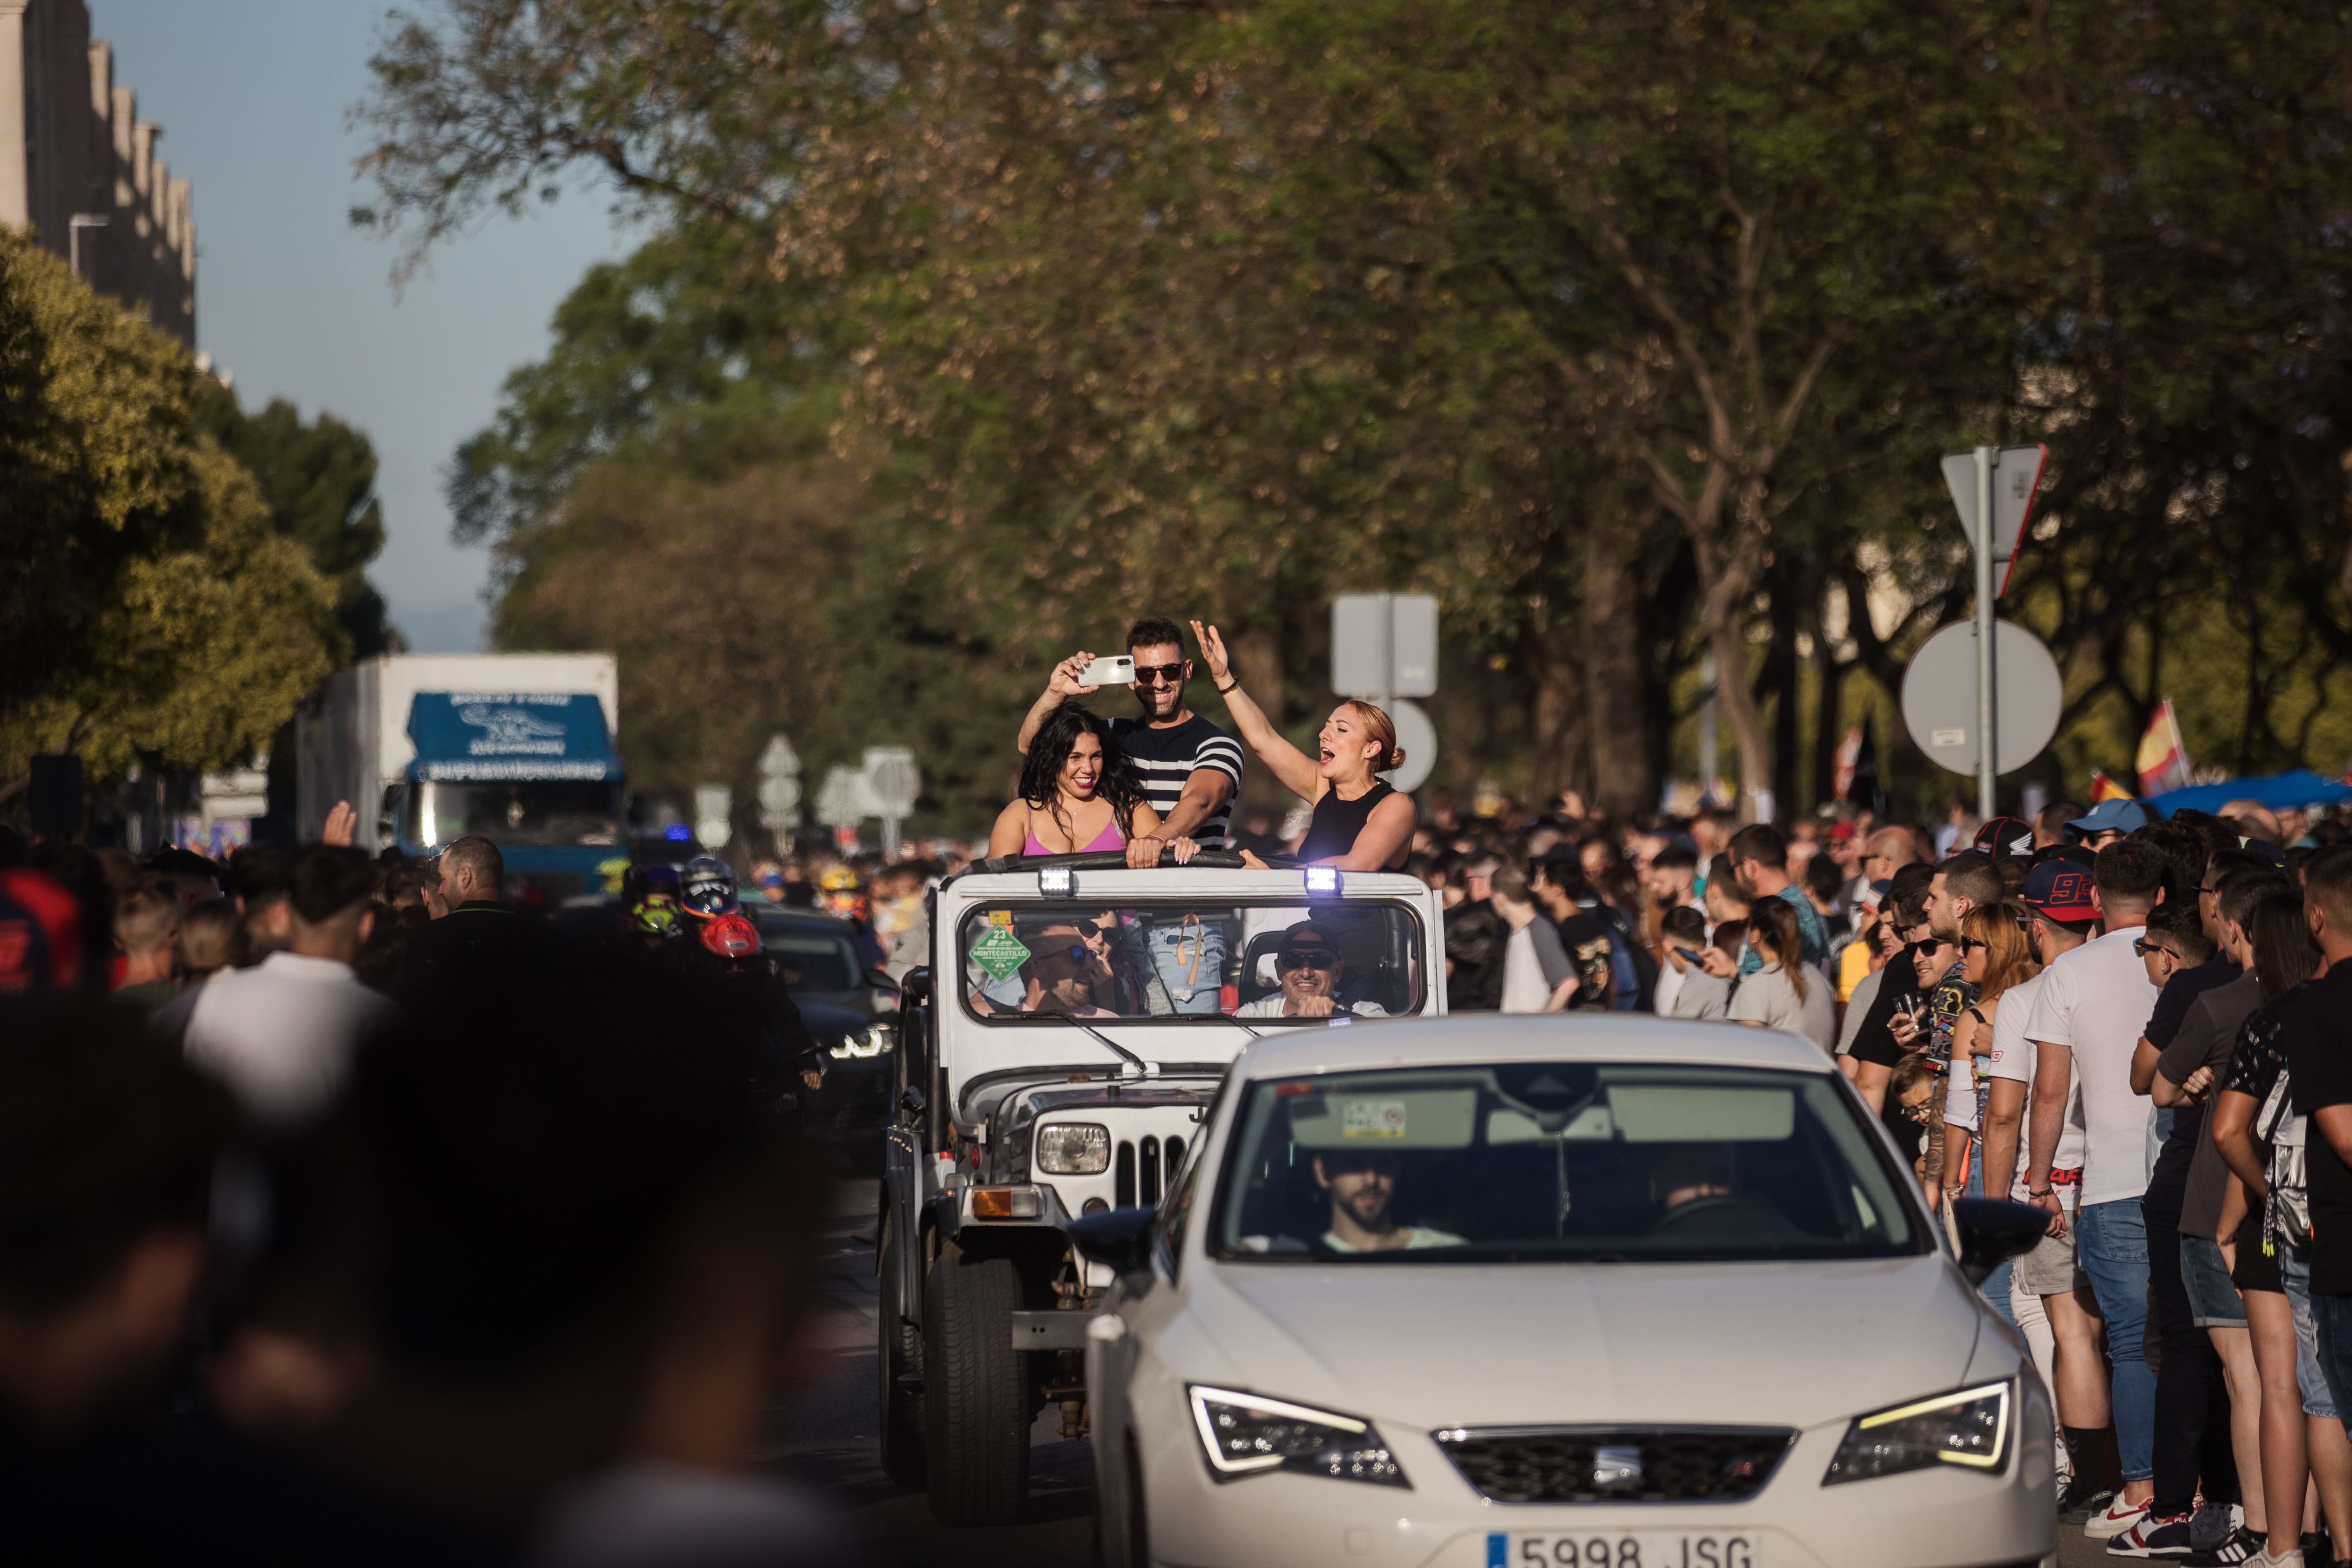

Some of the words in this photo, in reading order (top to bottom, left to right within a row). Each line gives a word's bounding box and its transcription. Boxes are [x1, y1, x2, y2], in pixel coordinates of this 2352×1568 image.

[2050, 873, 2094, 904] 93
[993, 930, 1006, 939] 23
[1523, 1538, 1641, 1568] 5998
[1665, 1538, 1751, 1568] JSG
